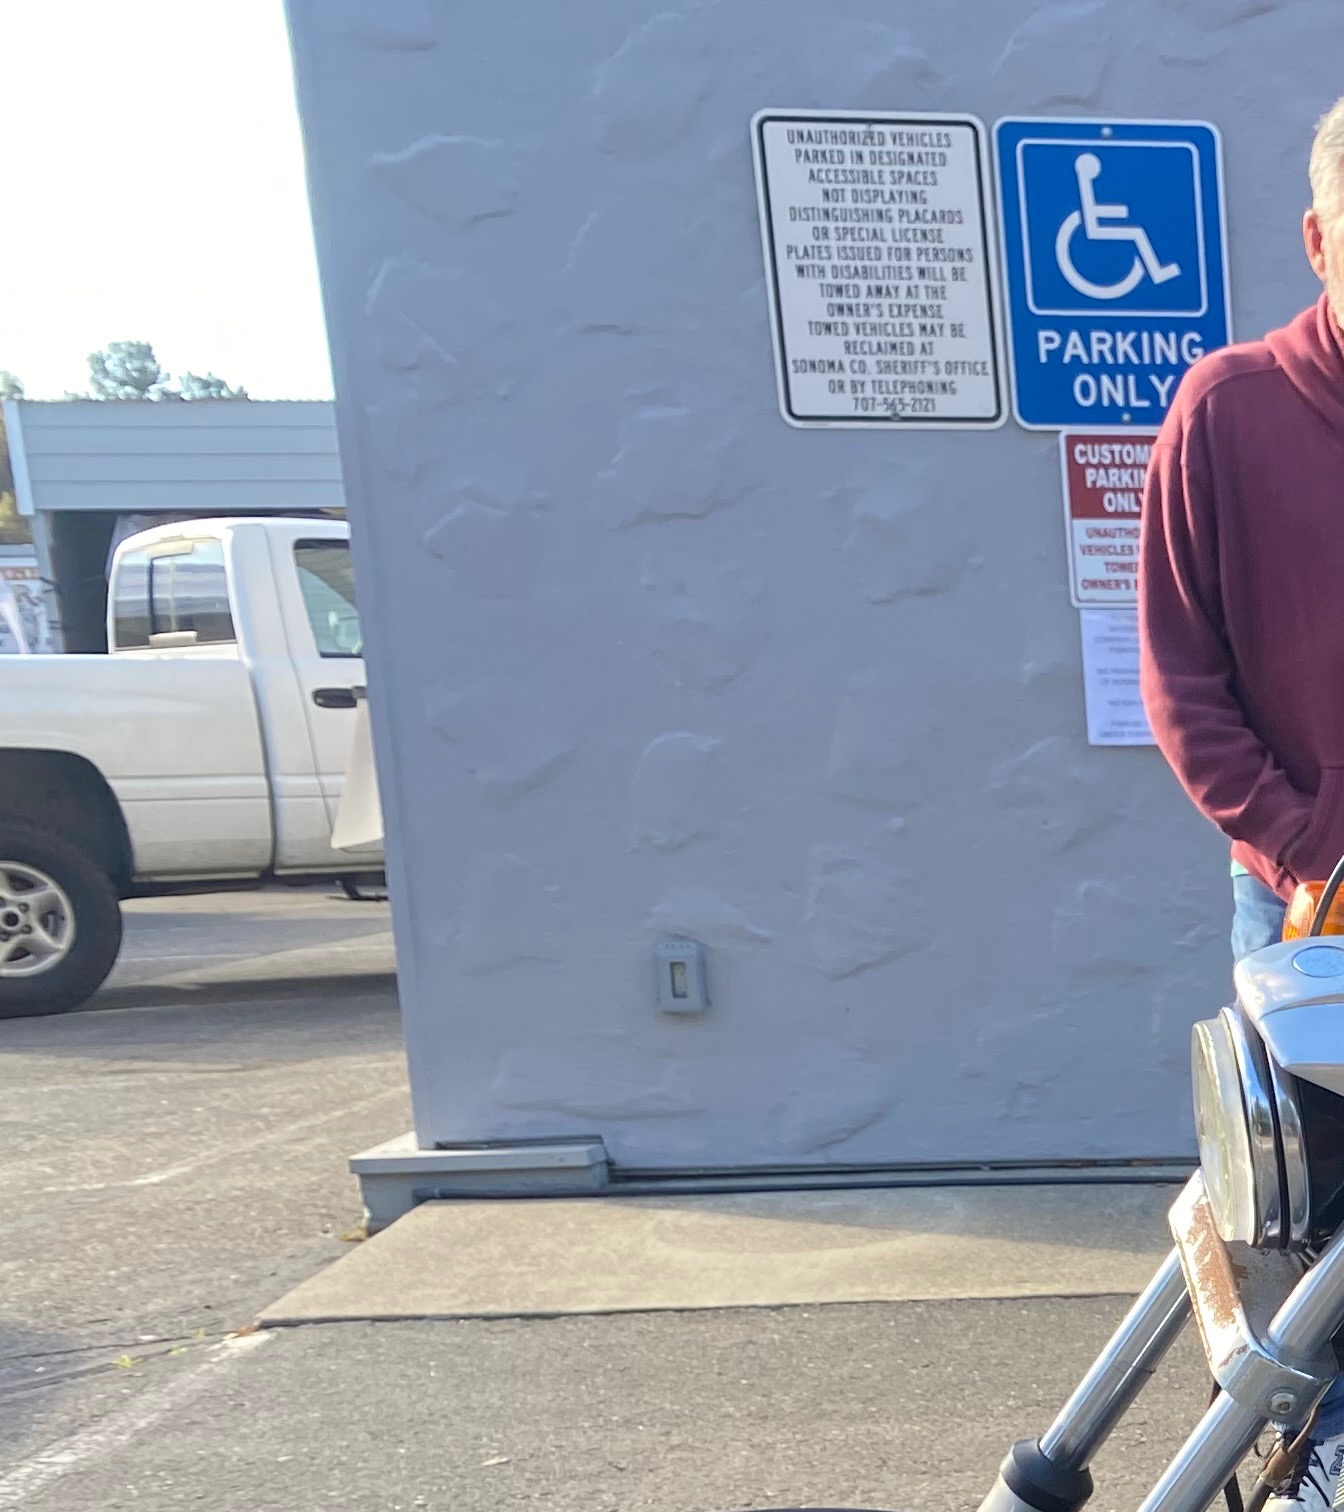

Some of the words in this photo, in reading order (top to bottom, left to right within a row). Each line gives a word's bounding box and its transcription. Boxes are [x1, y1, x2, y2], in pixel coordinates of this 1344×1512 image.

[786, 129, 885, 147] UNAUTHORIZED
[890, 131, 952, 148] VEHICLES
[795, 149, 845, 165] PARKED
[851, 151, 864, 166] IN
[869, 151, 947, 167] DESIGNATED
[808, 168, 885, 185] ACCESSIBLE
[889, 171, 938, 186] SPACES
[822, 188, 846, 203] NOT
[851, 189, 928, 205] DISPLAYING
[789, 207, 893, 224] DISTINGUISHING
[897, 209, 964, 225] PLACARDS
[812, 226, 828, 241] OR
[834, 227, 886, 243] SPECIAL
[891, 228, 944, 244] LICENSE
[786, 245, 832, 261] PLATES
[837, 246, 882, 261] ISSUED
[887, 247, 912, 262] FOR
[916, 247, 974, 263] PERSONS
[794, 264, 826, 279] WITH
[831, 264, 913, 281] DISABILITIES
[916, 266, 946, 282] WILL
[951, 267, 968, 282] BE
[819, 283, 860, 298] TOWED
[865, 284, 900, 299] AWAY
[905, 285, 920, 299] AT
[924, 285, 947, 300] THE
[827, 303, 884, 318] OWNER'S
[888, 303, 945, 319] EXPENSE
[808, 321, 849, 336] TOWED
[853, 322, 914, 337] VEHICLES
[919, 323, 945, 338] MAY
[950, 323, 967, 338] BE
[844, 340, 914, 356] RECLAIMED
[920, 341, 935, 356] AT
[1037, 329, 1204, 366] PARKING
[792, 359, 846, 374] SONOMA
[875, 360, 940, 375] SHERIFF'S
[944, 361, 990, 376] OFFICE
[828, 379, 846, 394] OR
[850, 380, 866, 394] BY
[871, 380, 957, 396] TELEPHONING
[1073, 374, 1176, 409] ONLY
[1074, 444, 1151, 465] CUSTOM
[1085, 468, 1145, 489] PARKI
[1085, 527, 1140, 539] UNAUTHO
[1104, 562, 1139, 573] TOWE
